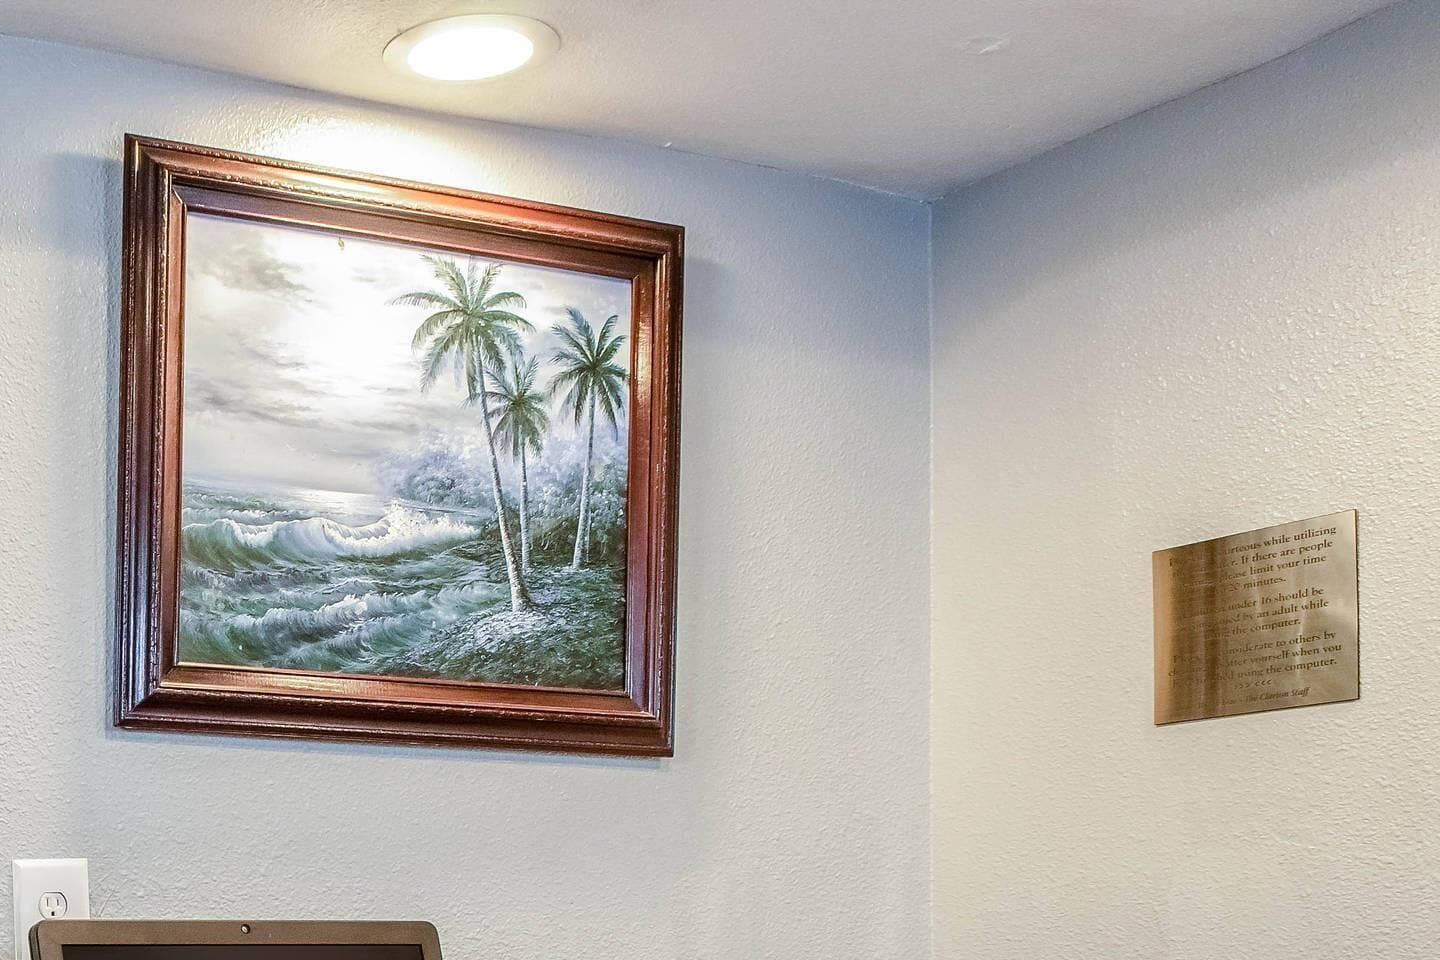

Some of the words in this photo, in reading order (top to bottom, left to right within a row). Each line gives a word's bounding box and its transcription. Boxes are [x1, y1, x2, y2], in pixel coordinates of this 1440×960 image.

[1263, 535, 1291, 547] while
[1294, 525, 1337, 541] utilizing
[1252, 551, 1278, 563] there
[1280, 548, 1296, 558] are
[1298, 540, 1333, 555] people
[1250, 563, 1274, 576] limit
[1276, 561, 1300, 572] your
[1303, 555, 1327, 565] time
[1243, 577, 1287, 590] minutes.
[1274, 588, 1308, 602] should
[1311, 586, 1325, 596] be
[1271, 603, 1299, 616] adult
[1301, 599, 1329, 611] while
[1232, 624, 1247, 635] the
[1249, 618, 1302, 634] computer.
[1276, 640, 1287, 648] to
[1288, 634, 1321, 646] others
[1323, 631, 1337, 642] by
[1250, 649, 1291, 665] yourself
[1292, 648, 1320, 658] when
[1323, 644, 1342, 654] you
[1266, 664, 1282, 675] the
[1284, 657, 1338, 672] computer.
